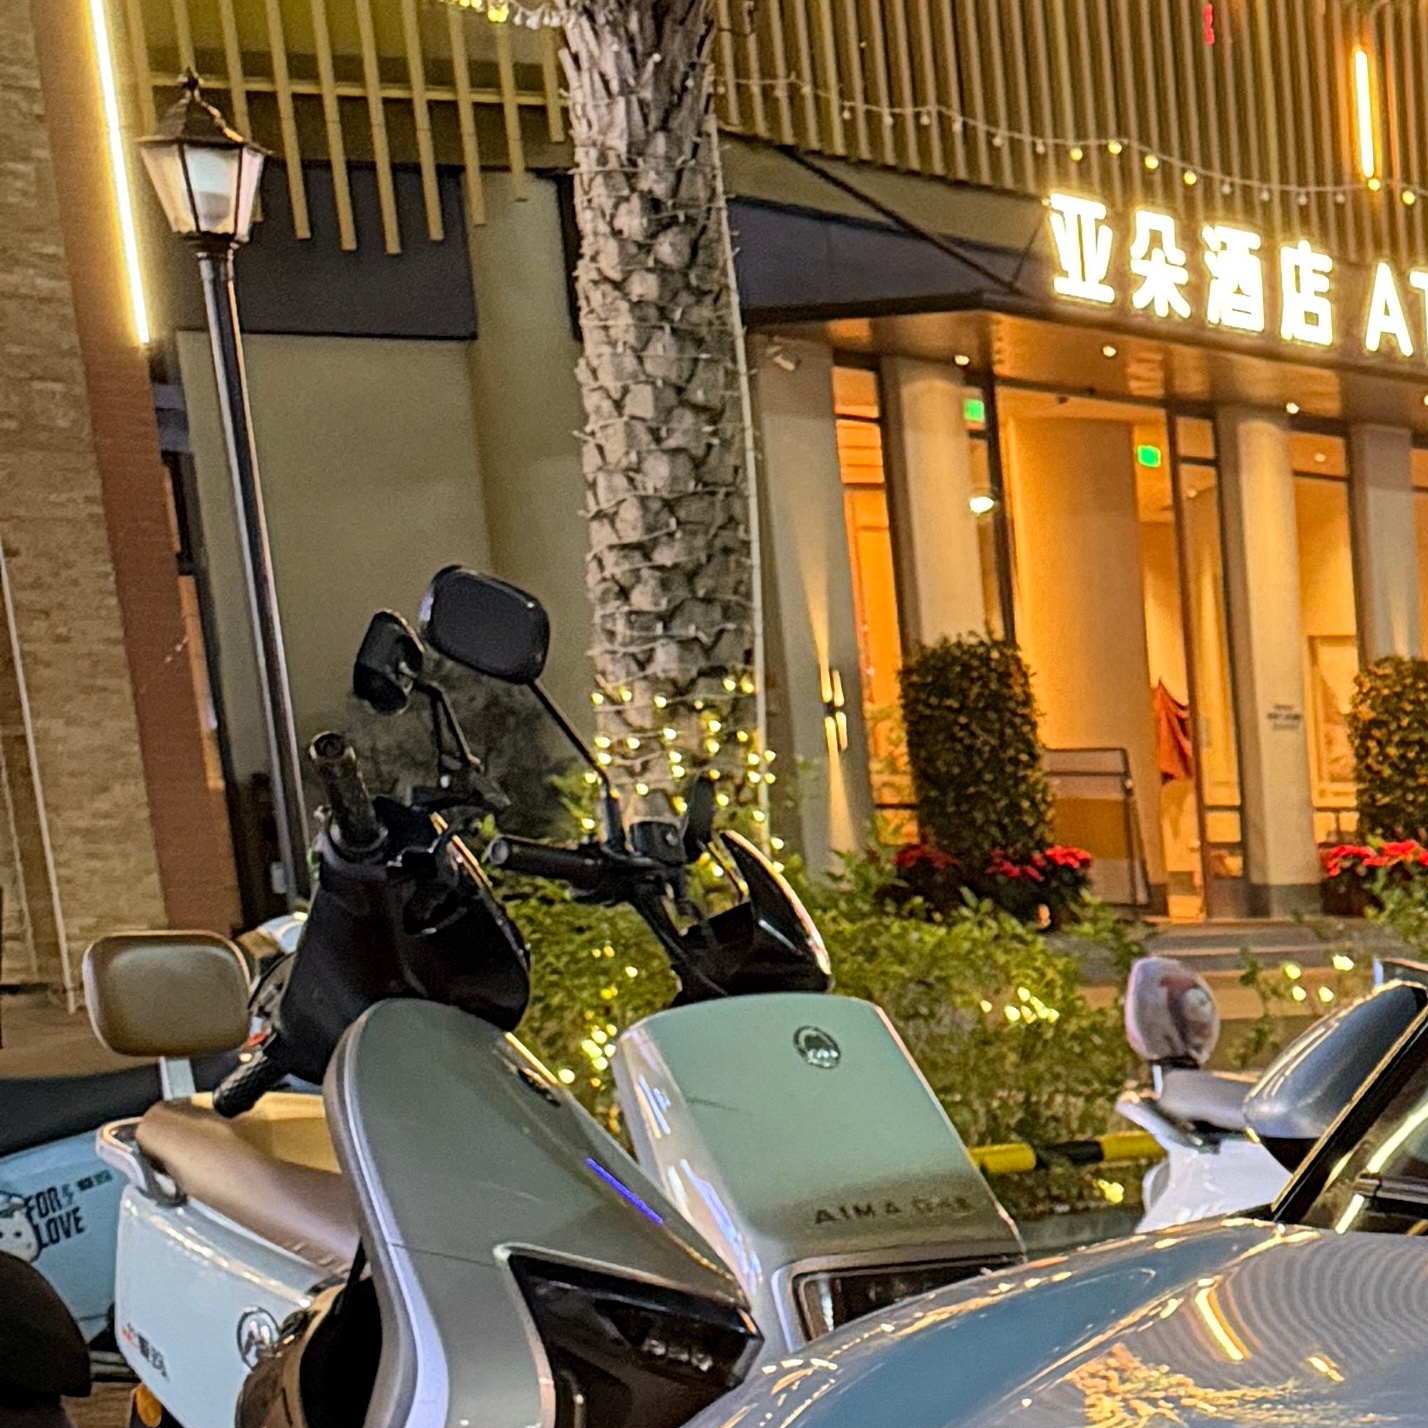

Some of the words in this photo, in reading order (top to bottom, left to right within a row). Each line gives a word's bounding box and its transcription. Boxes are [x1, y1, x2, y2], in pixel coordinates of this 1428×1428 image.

[1050, 192, 1333, 347] 亚朵酒店
[24, 1186, 62, 1226] FOR
[34, 1206, 85, 1248] LOVE
